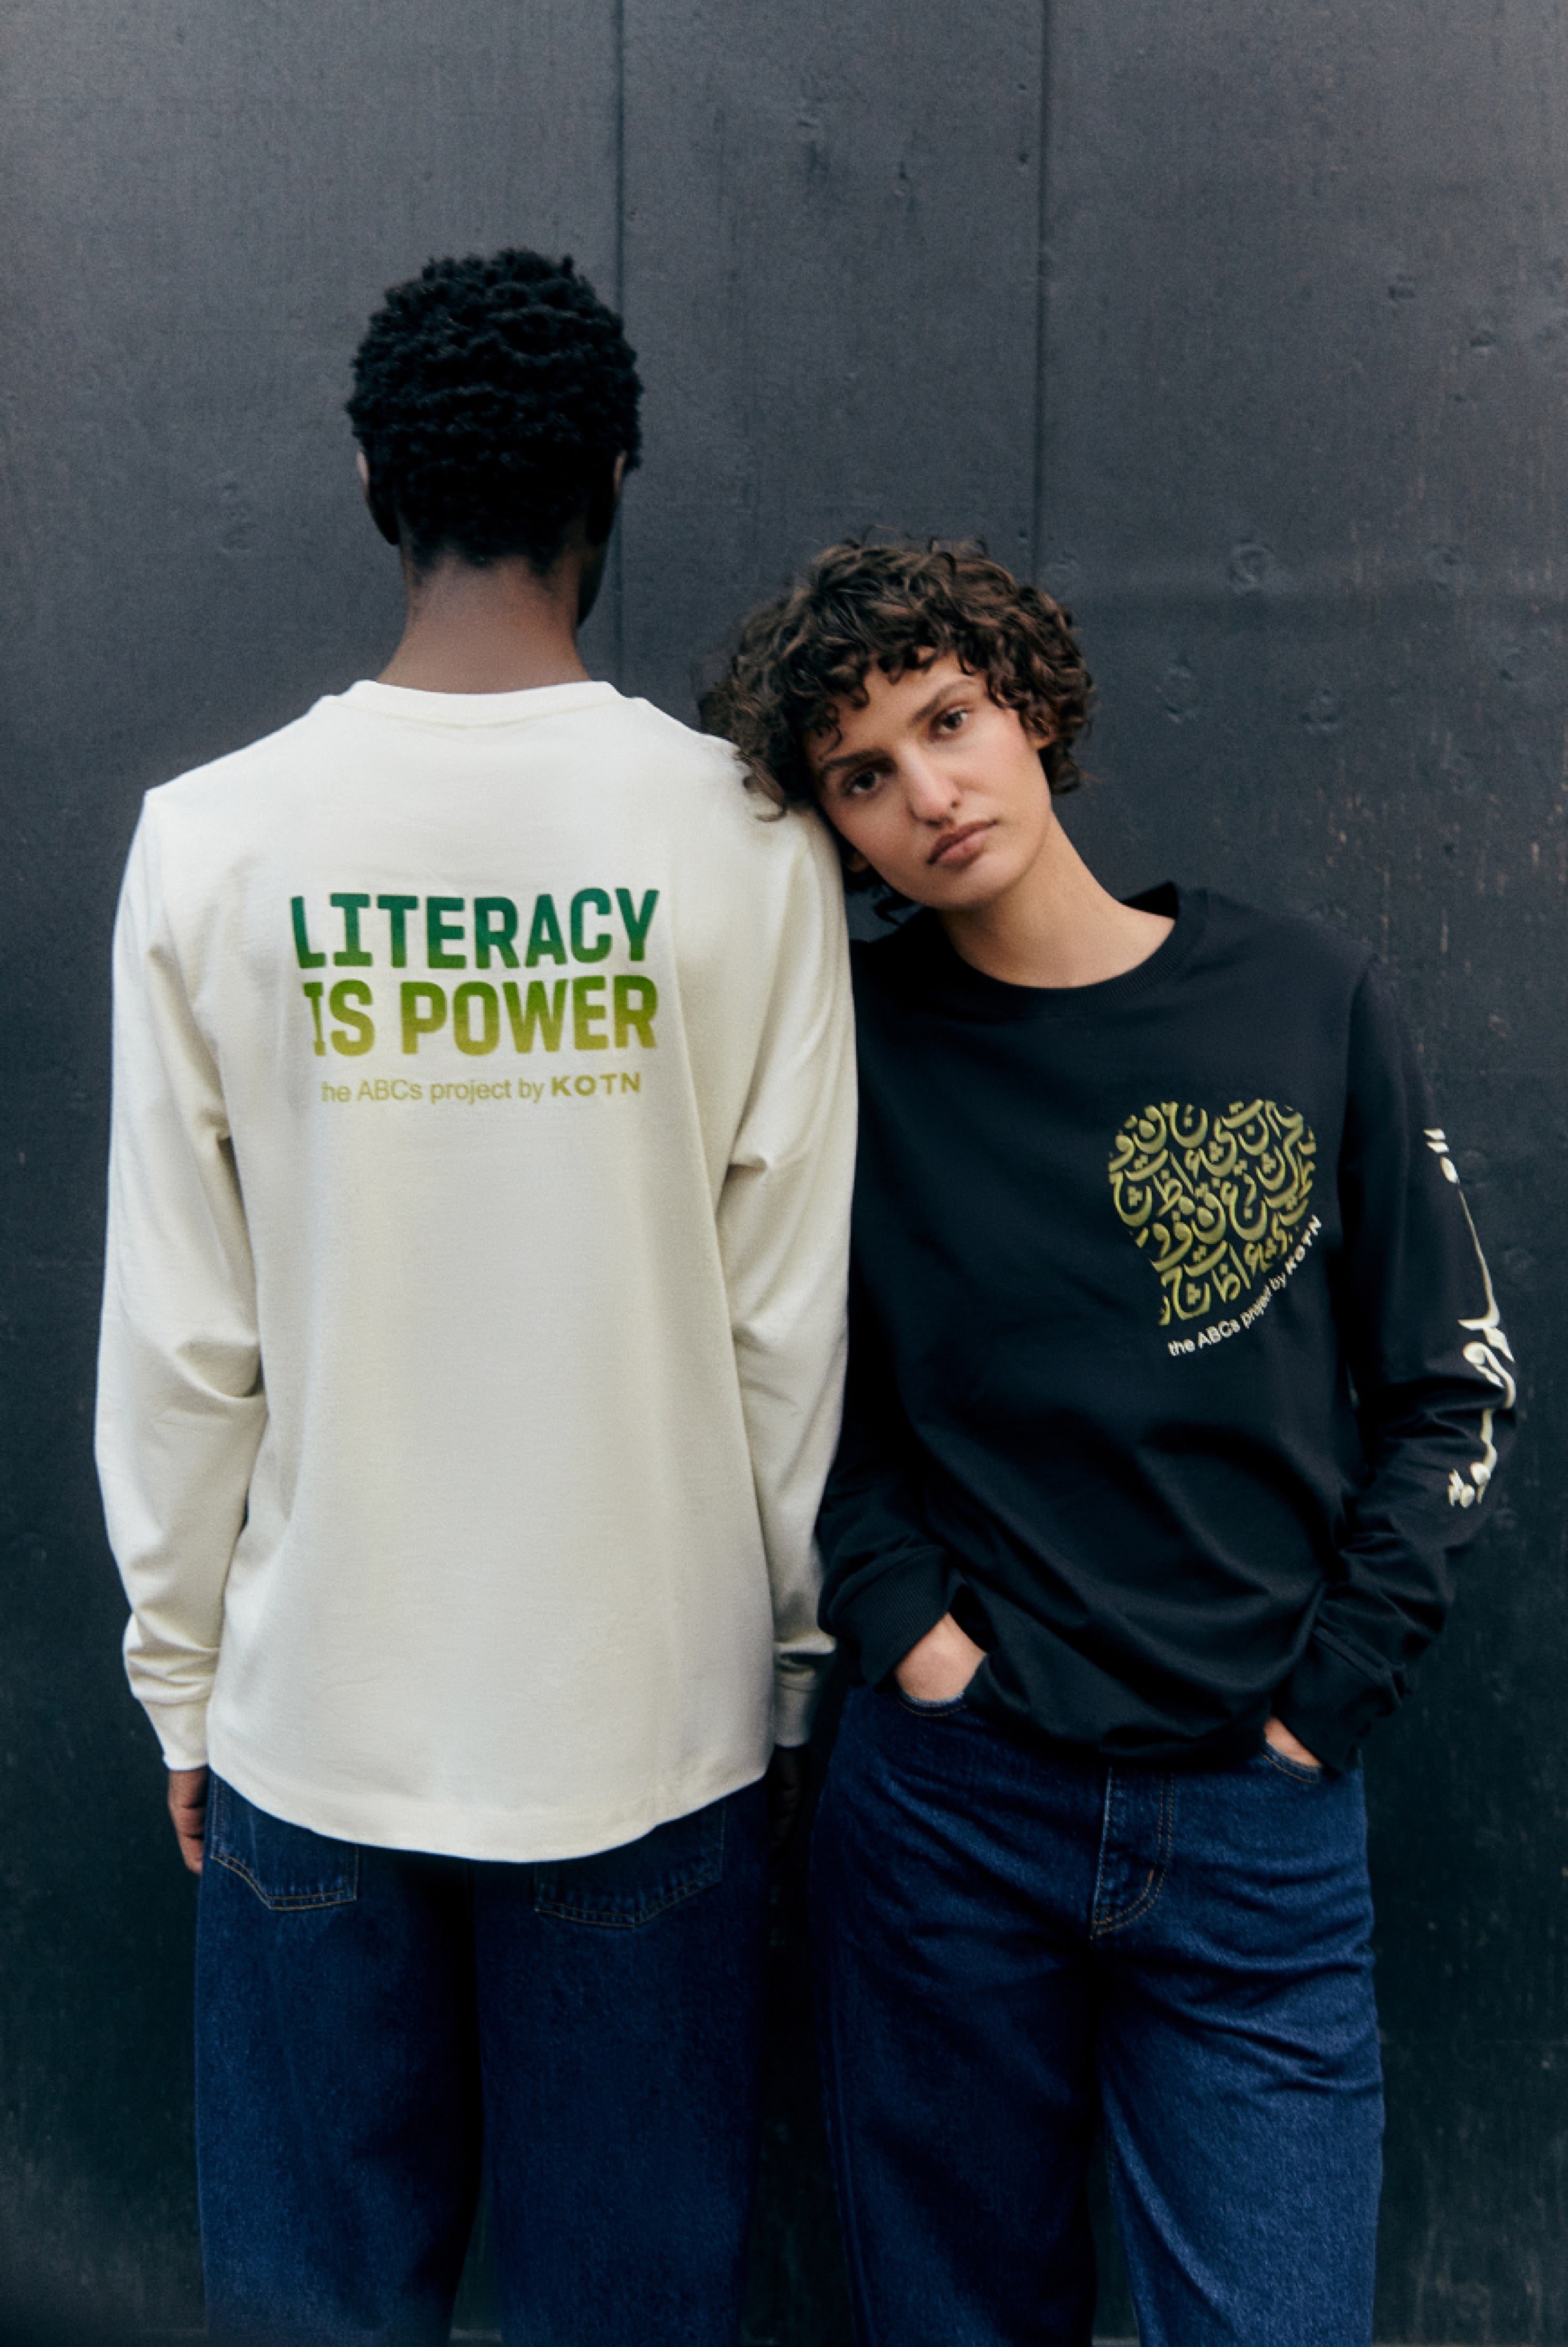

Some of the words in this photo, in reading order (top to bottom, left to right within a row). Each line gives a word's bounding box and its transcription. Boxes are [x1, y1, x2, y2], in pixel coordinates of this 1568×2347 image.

[291, 888, 659, 969] LITERACY
[302, 979, 375, 1056] IS
[400, 975, 658, 1056] POWER
[357, 1079, 423, 1101] ABCs
[429, 1079, 512, 1105] project
[518, 1077, 545, 1103] by
[551, 1072, 641, 1097] KOTN
[1167, 1339, 1195, 1356] the
[1197, 1319, 1241, 1349] ABCs
[1284, 1213, 1322, 1275] KOTN
